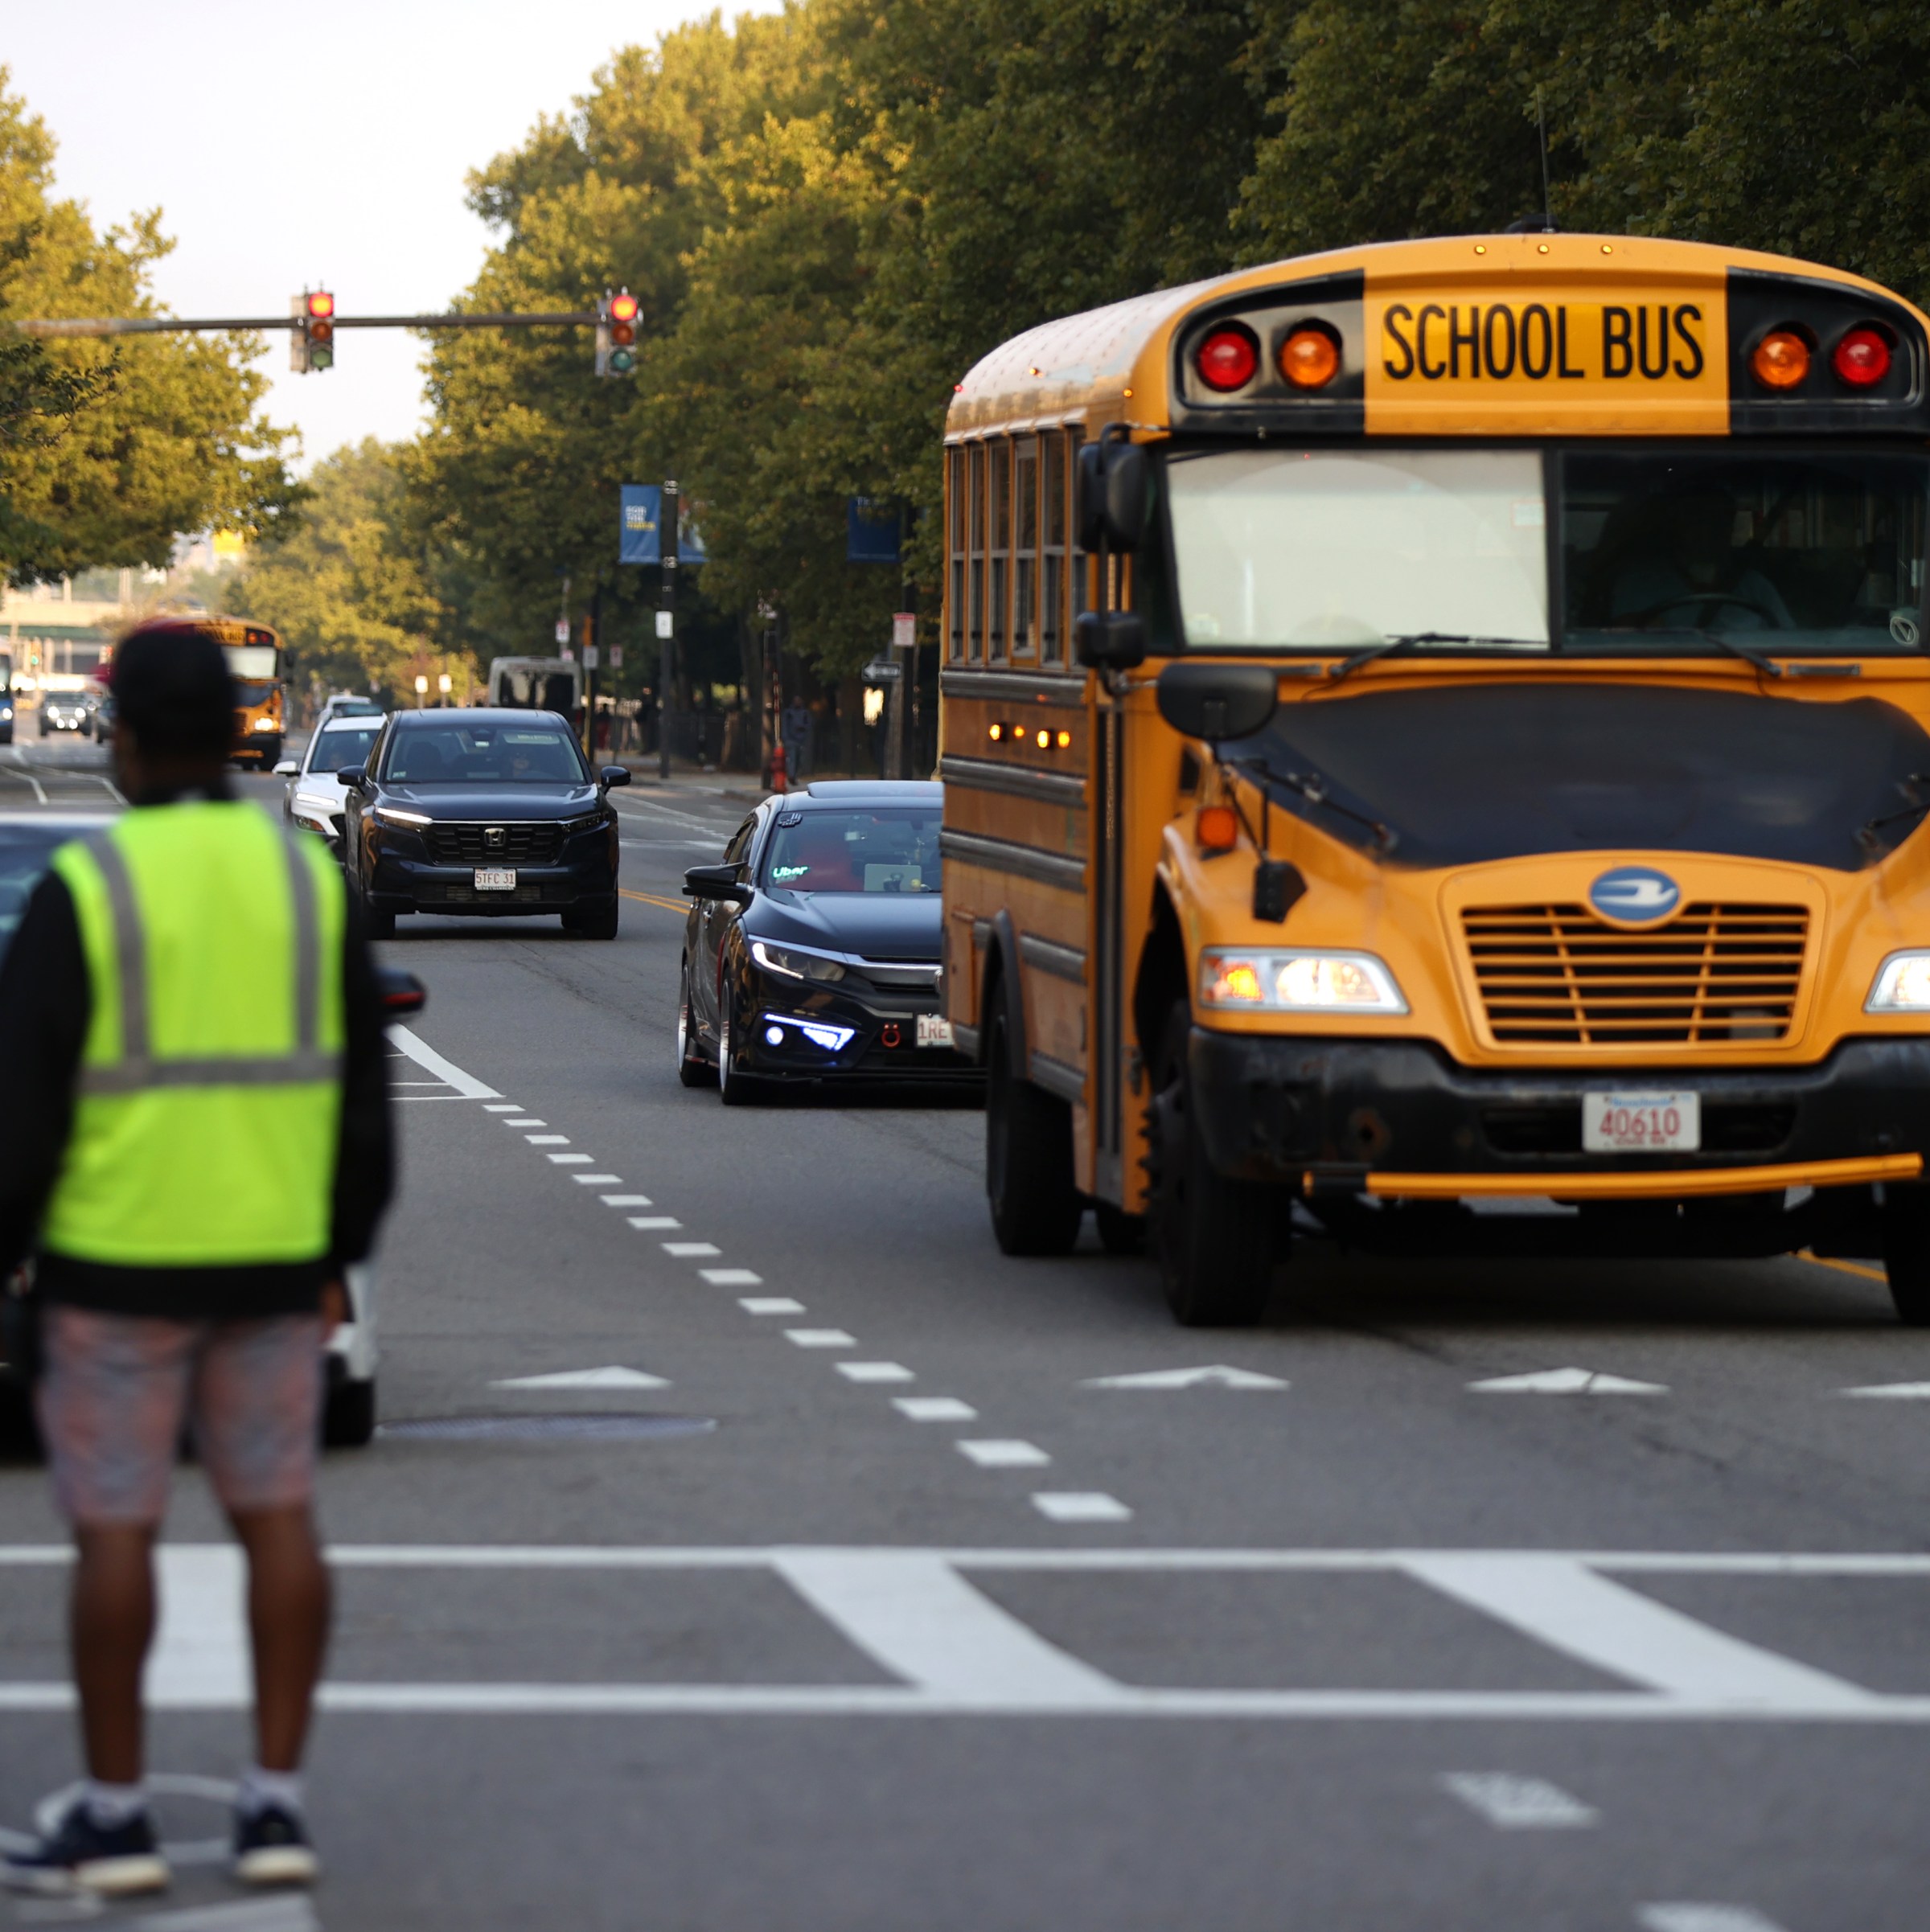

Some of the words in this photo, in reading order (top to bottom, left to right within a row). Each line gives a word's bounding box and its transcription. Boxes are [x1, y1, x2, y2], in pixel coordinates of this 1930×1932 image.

[1382, 303, 1585, 380] SCHOOL
[1602, 303, 1704, 380] BUS
[475, 873, 500, 884] 5TFC
[503, 873, 515, 884] 31
[773, 866, 807, 878] Uber
[1599, 1108, 1681, 1136] 40610
